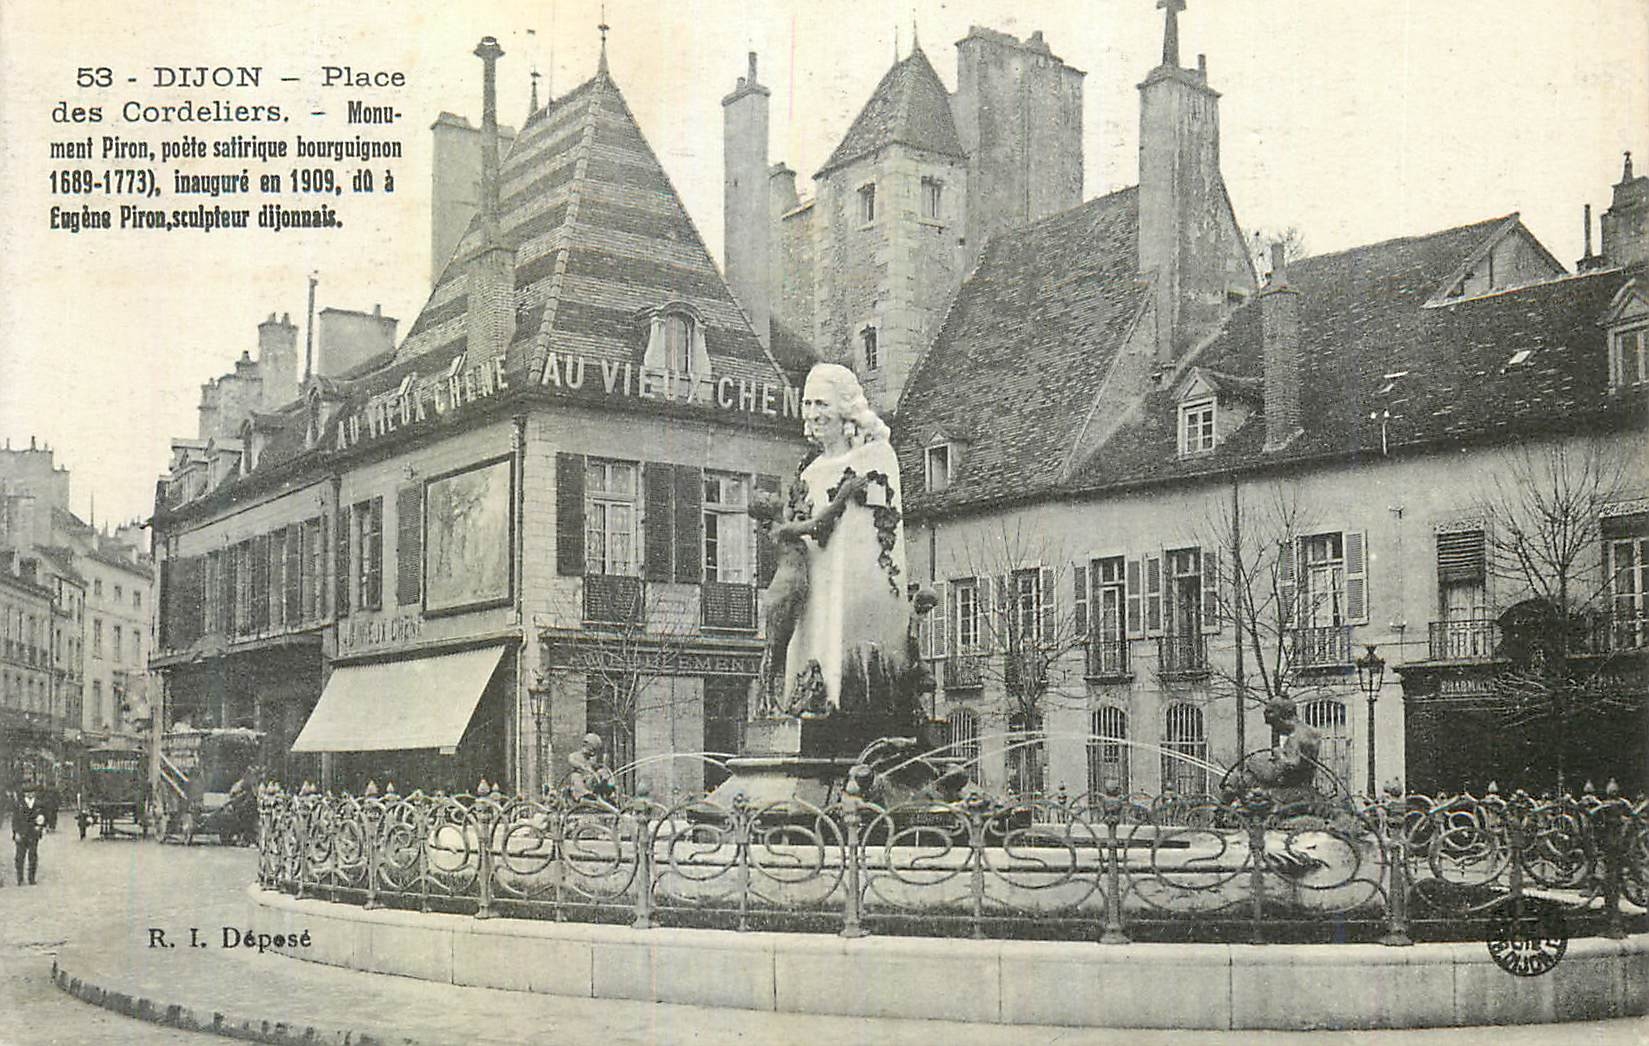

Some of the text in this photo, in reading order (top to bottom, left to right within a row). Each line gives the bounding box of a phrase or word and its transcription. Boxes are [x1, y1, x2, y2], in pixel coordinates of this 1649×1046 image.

[542, 352, 801, 419] AU VIEUX CHEN
[336, 413, 360, 450] AU
